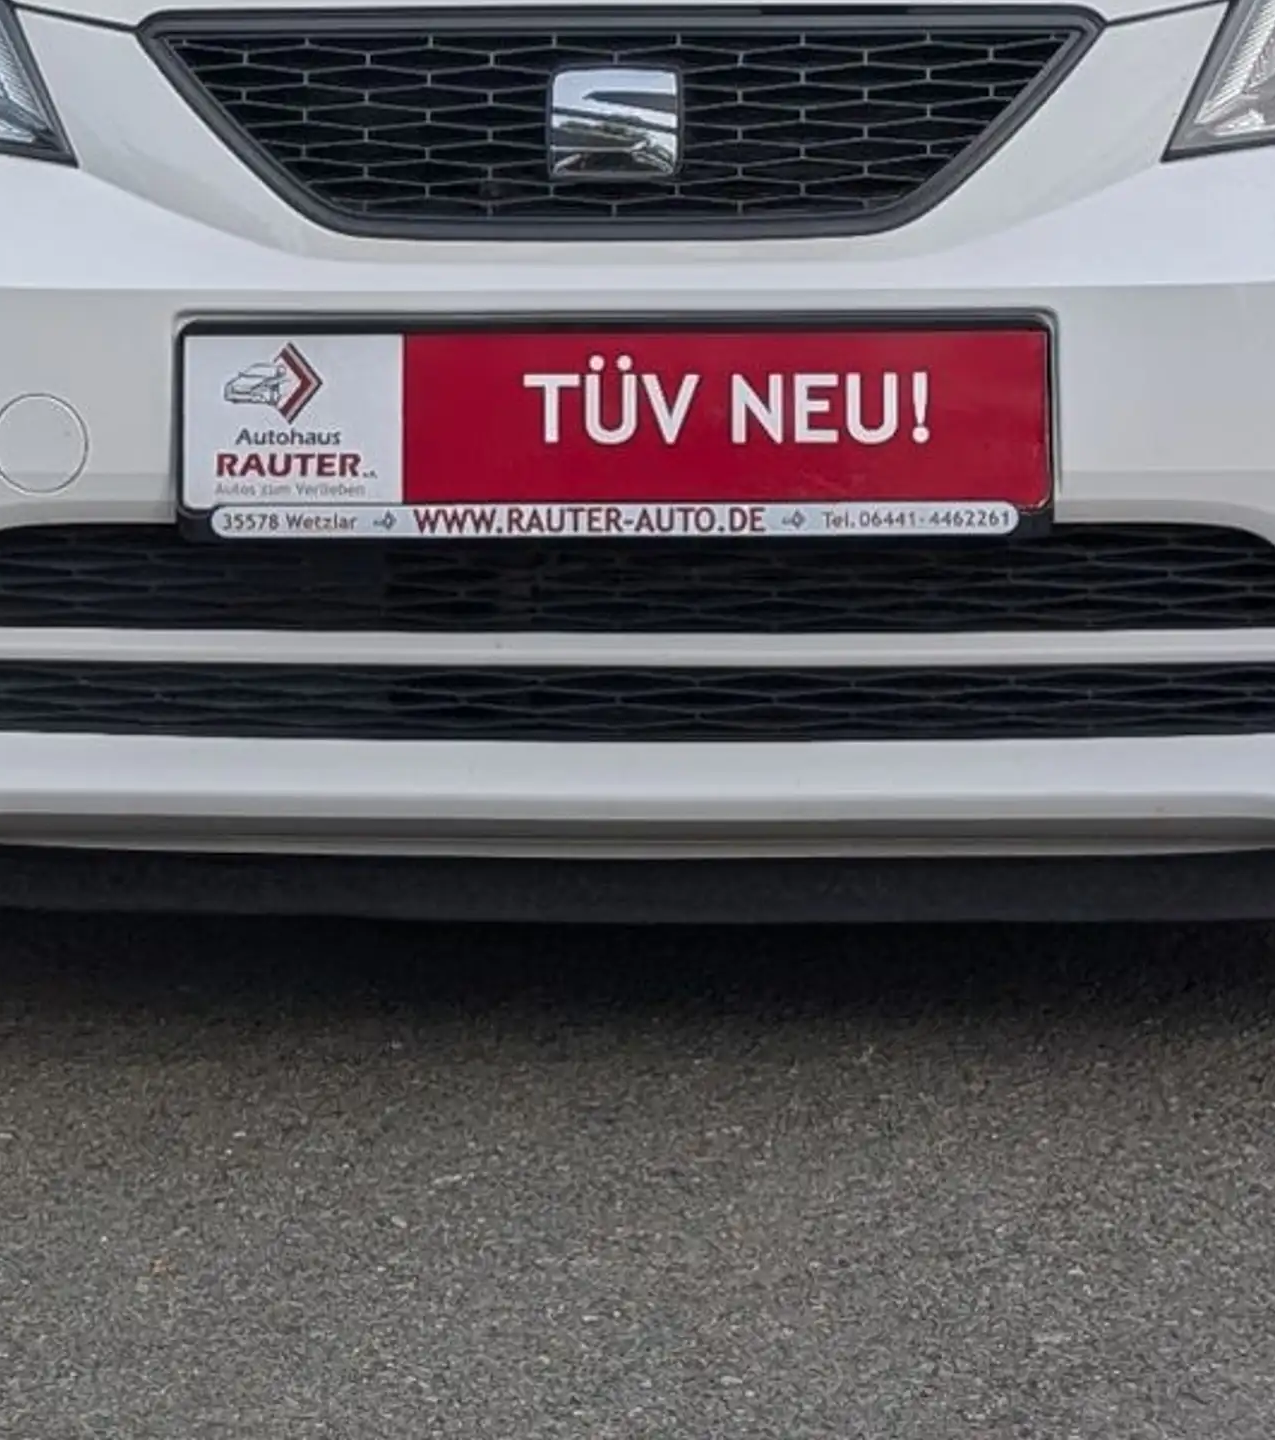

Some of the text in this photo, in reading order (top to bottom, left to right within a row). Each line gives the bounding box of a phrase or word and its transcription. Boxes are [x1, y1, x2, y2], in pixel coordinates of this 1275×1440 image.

[523, 355, 931, 445] TÜV NEU!
[234, 427, 342, 446] Autohaus
[214, 452, 362, 478] RAUTER
[222, 512, 280, 531] 35578
[285, 511, 358, 531] Wetzlar
[413, 508, 766, 534] WWW.RAUTER-AUTO.DE
